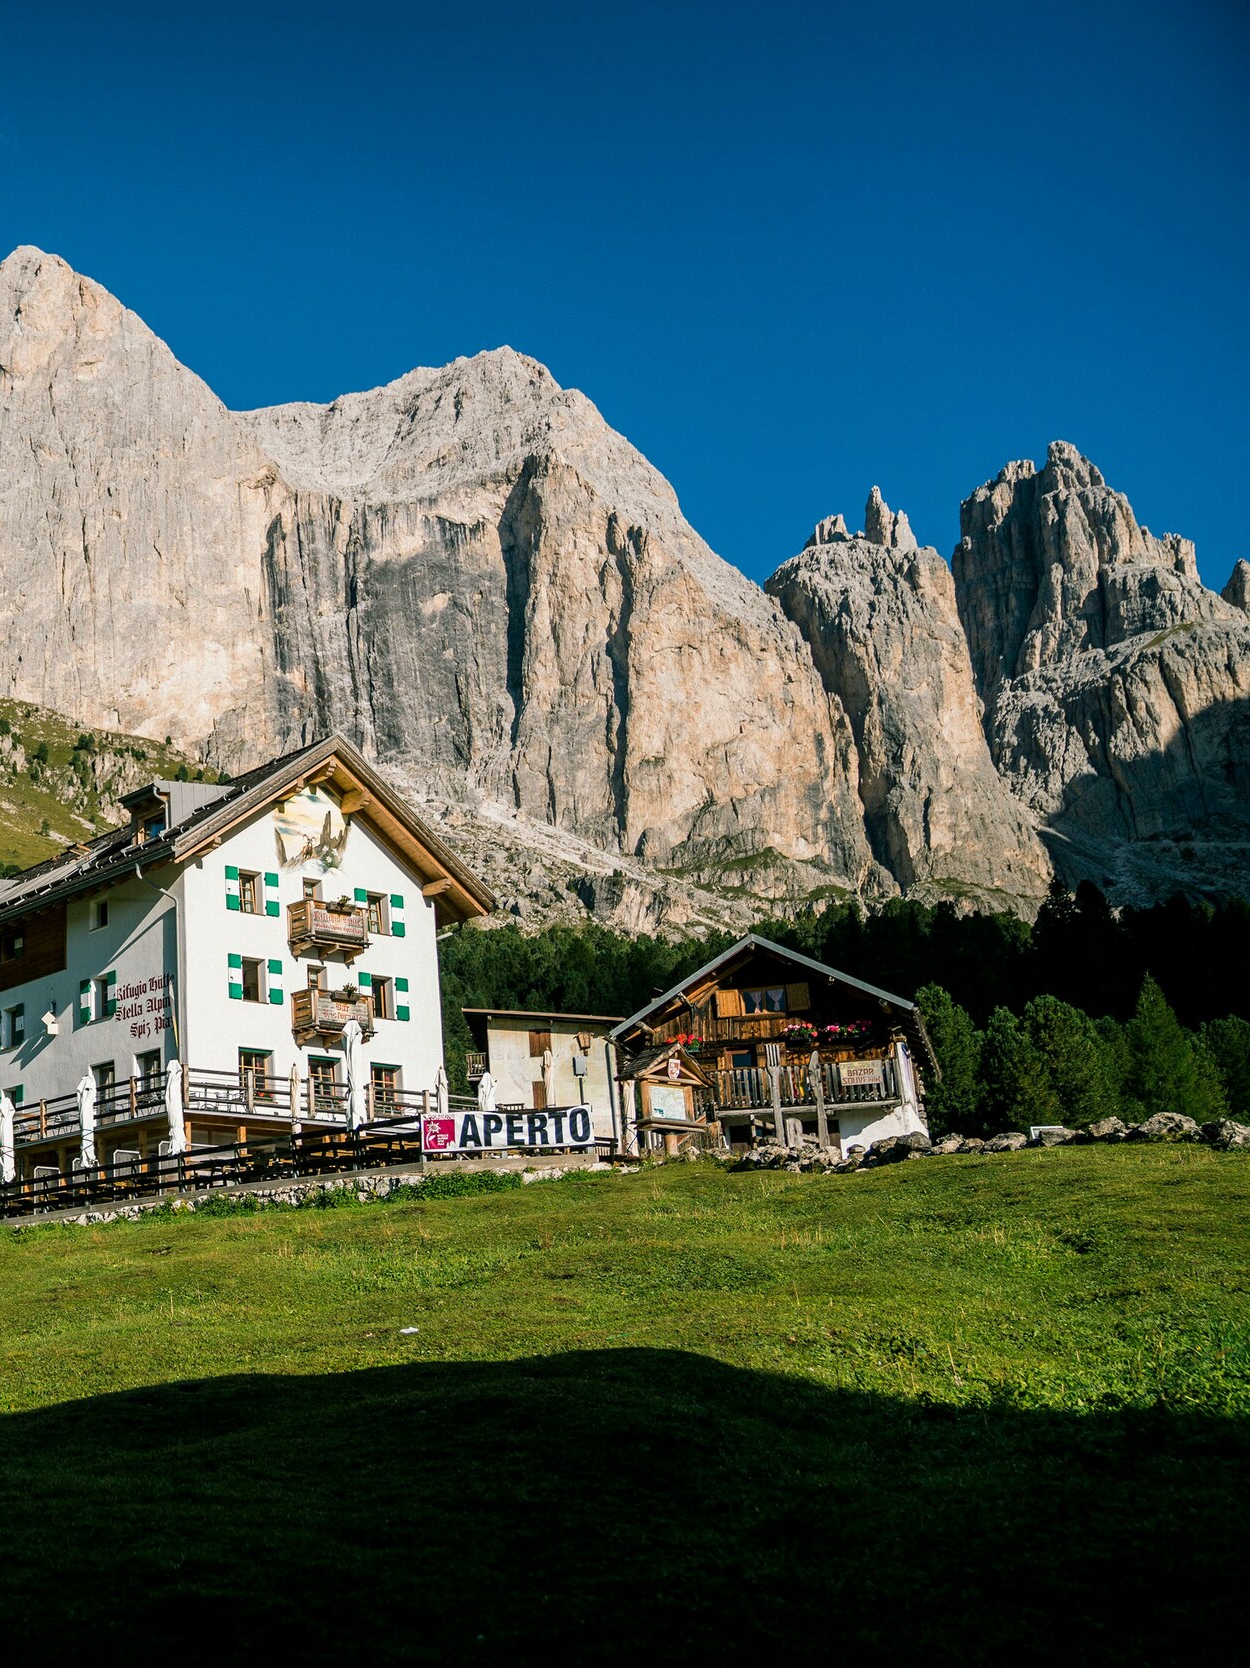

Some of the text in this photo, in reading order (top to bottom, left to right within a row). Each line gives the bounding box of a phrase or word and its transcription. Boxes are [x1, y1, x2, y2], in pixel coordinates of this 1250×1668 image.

[114, 980, 147, 1001] Rifugio
[115, 993, 171, 1022] Stella Alpin
[335, 1002, 349, 1012] Bar
[847, 1067, 875, 1077] BAZAR
[842, 1076, 880, 1085] SOUVENIR
[459, 1107, 591, 1148] APERTO
